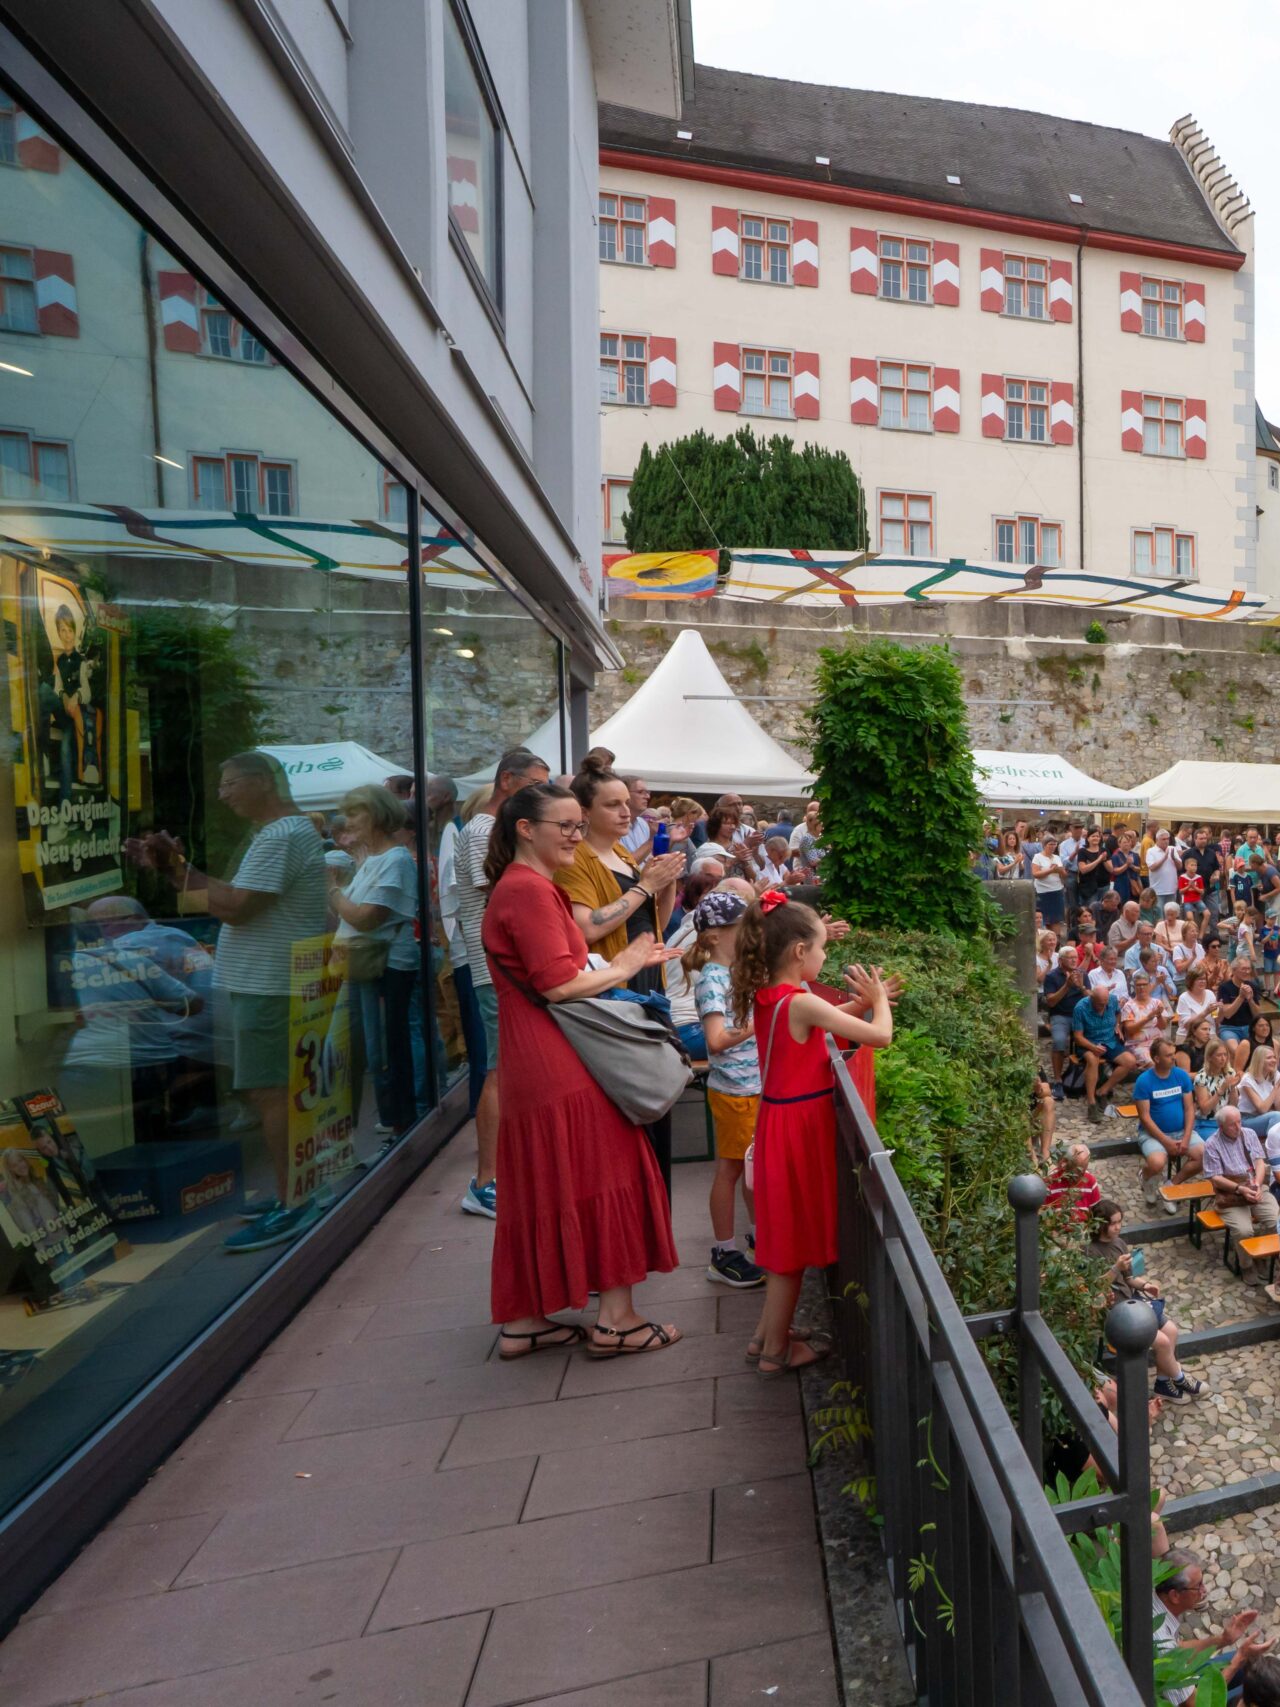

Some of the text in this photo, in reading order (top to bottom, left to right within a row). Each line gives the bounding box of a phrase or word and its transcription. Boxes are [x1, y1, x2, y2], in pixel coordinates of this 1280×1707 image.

[27, 800, 59, 827] Das
[36, 841, 70, 867] Neu
[71, 962, 163, 989] Schule
[295, 1115, 352, 1168] SOMMER
[184, 1178, 233, 1211] Scout
[47, 1197, 98, 1233] Original.
[34, 1243, 63, 1265] Neu
[63, 1212, 113, 1254] gedacht.
